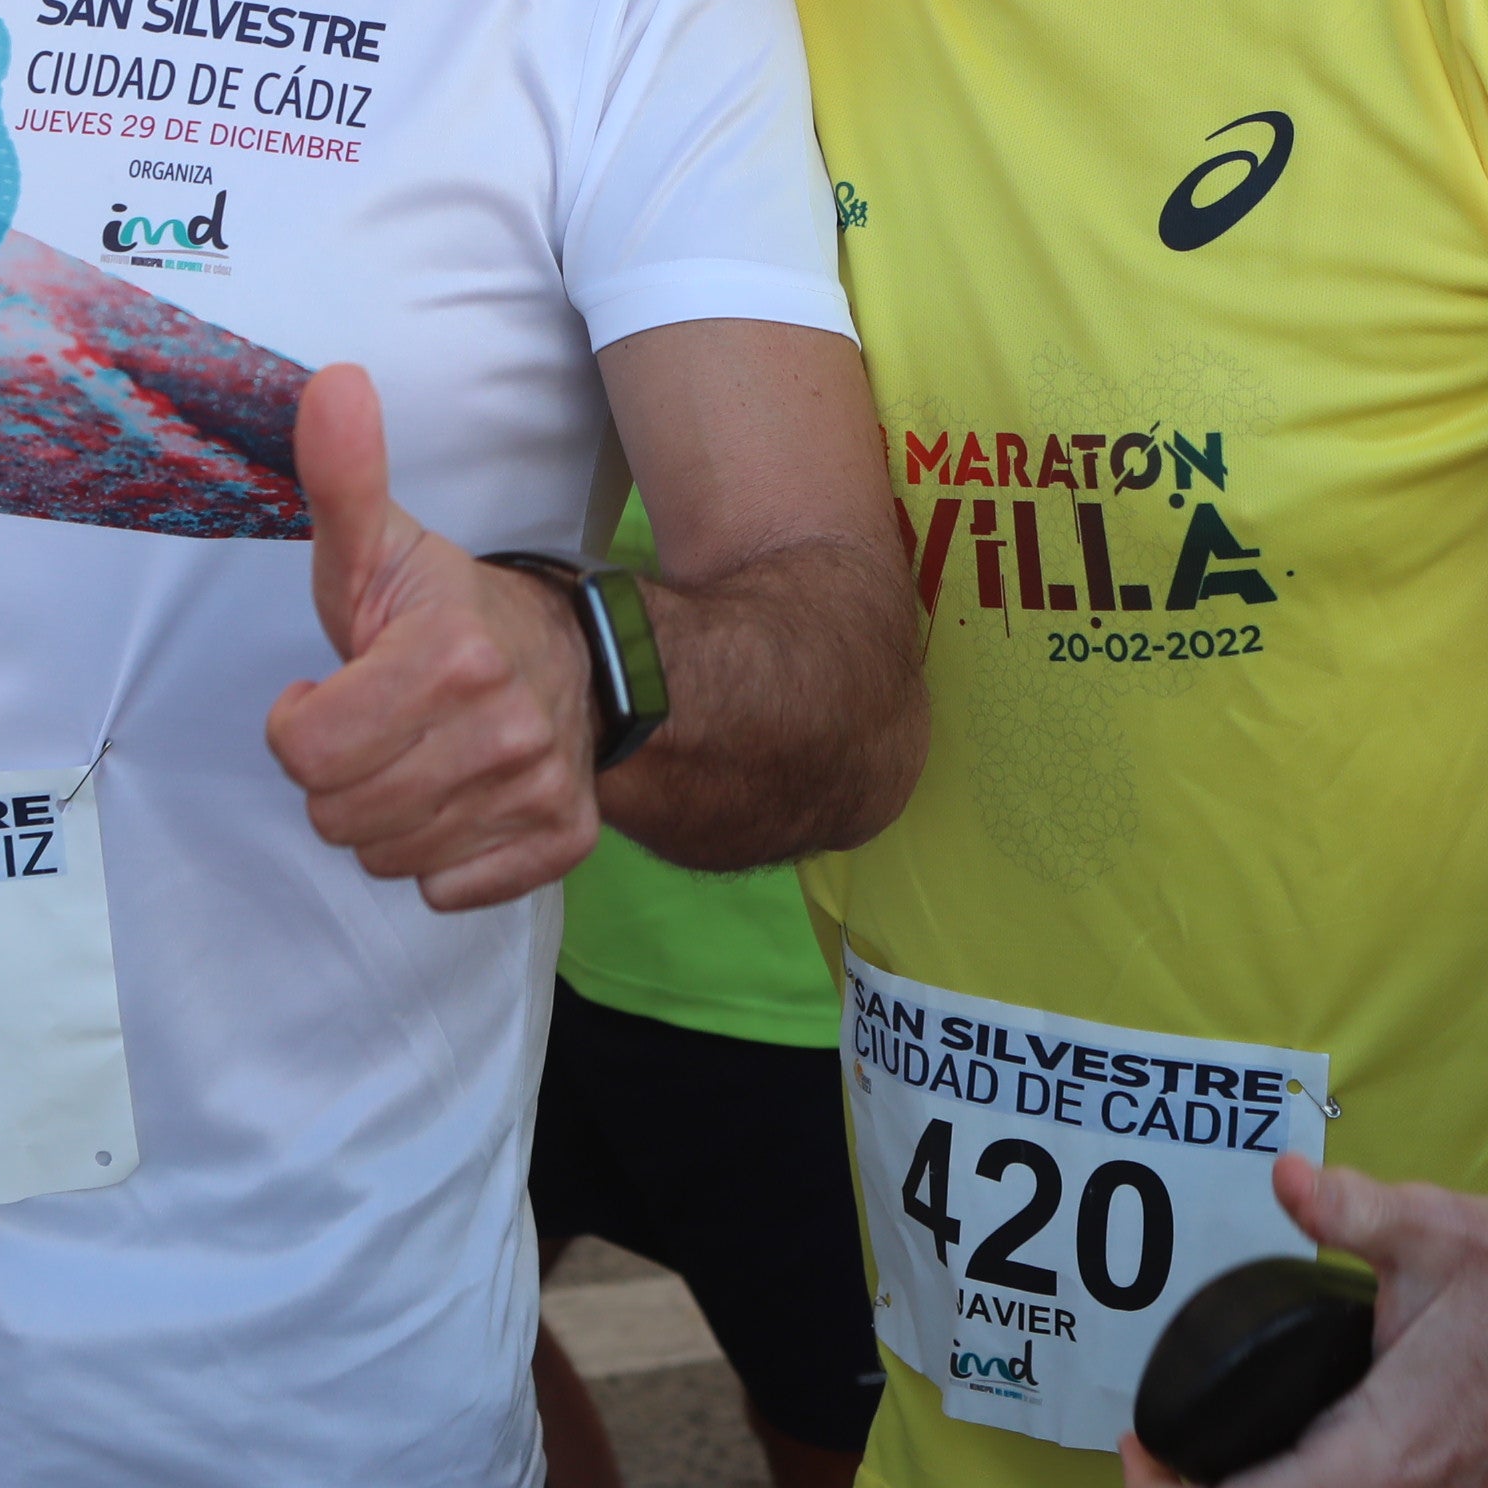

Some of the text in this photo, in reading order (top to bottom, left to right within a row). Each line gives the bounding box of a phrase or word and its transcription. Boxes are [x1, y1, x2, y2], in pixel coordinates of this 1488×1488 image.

[27, 50, 372, 128] CIUDAD DE CÁDIZ
[15, 109, 362, 163] JUEVES 29 DE DICIEMBRE
[128, 159, 213, 185] ORGANIZA
[1048, 624, 1264, 663] 20-02-2022
[855, 978, 1284, 1105] SAN SILVESTRE
[854, 1015, 1279, 1154] CIUDAD DE CÁDIZ
[902, 1118, 1174, 1312] 420
